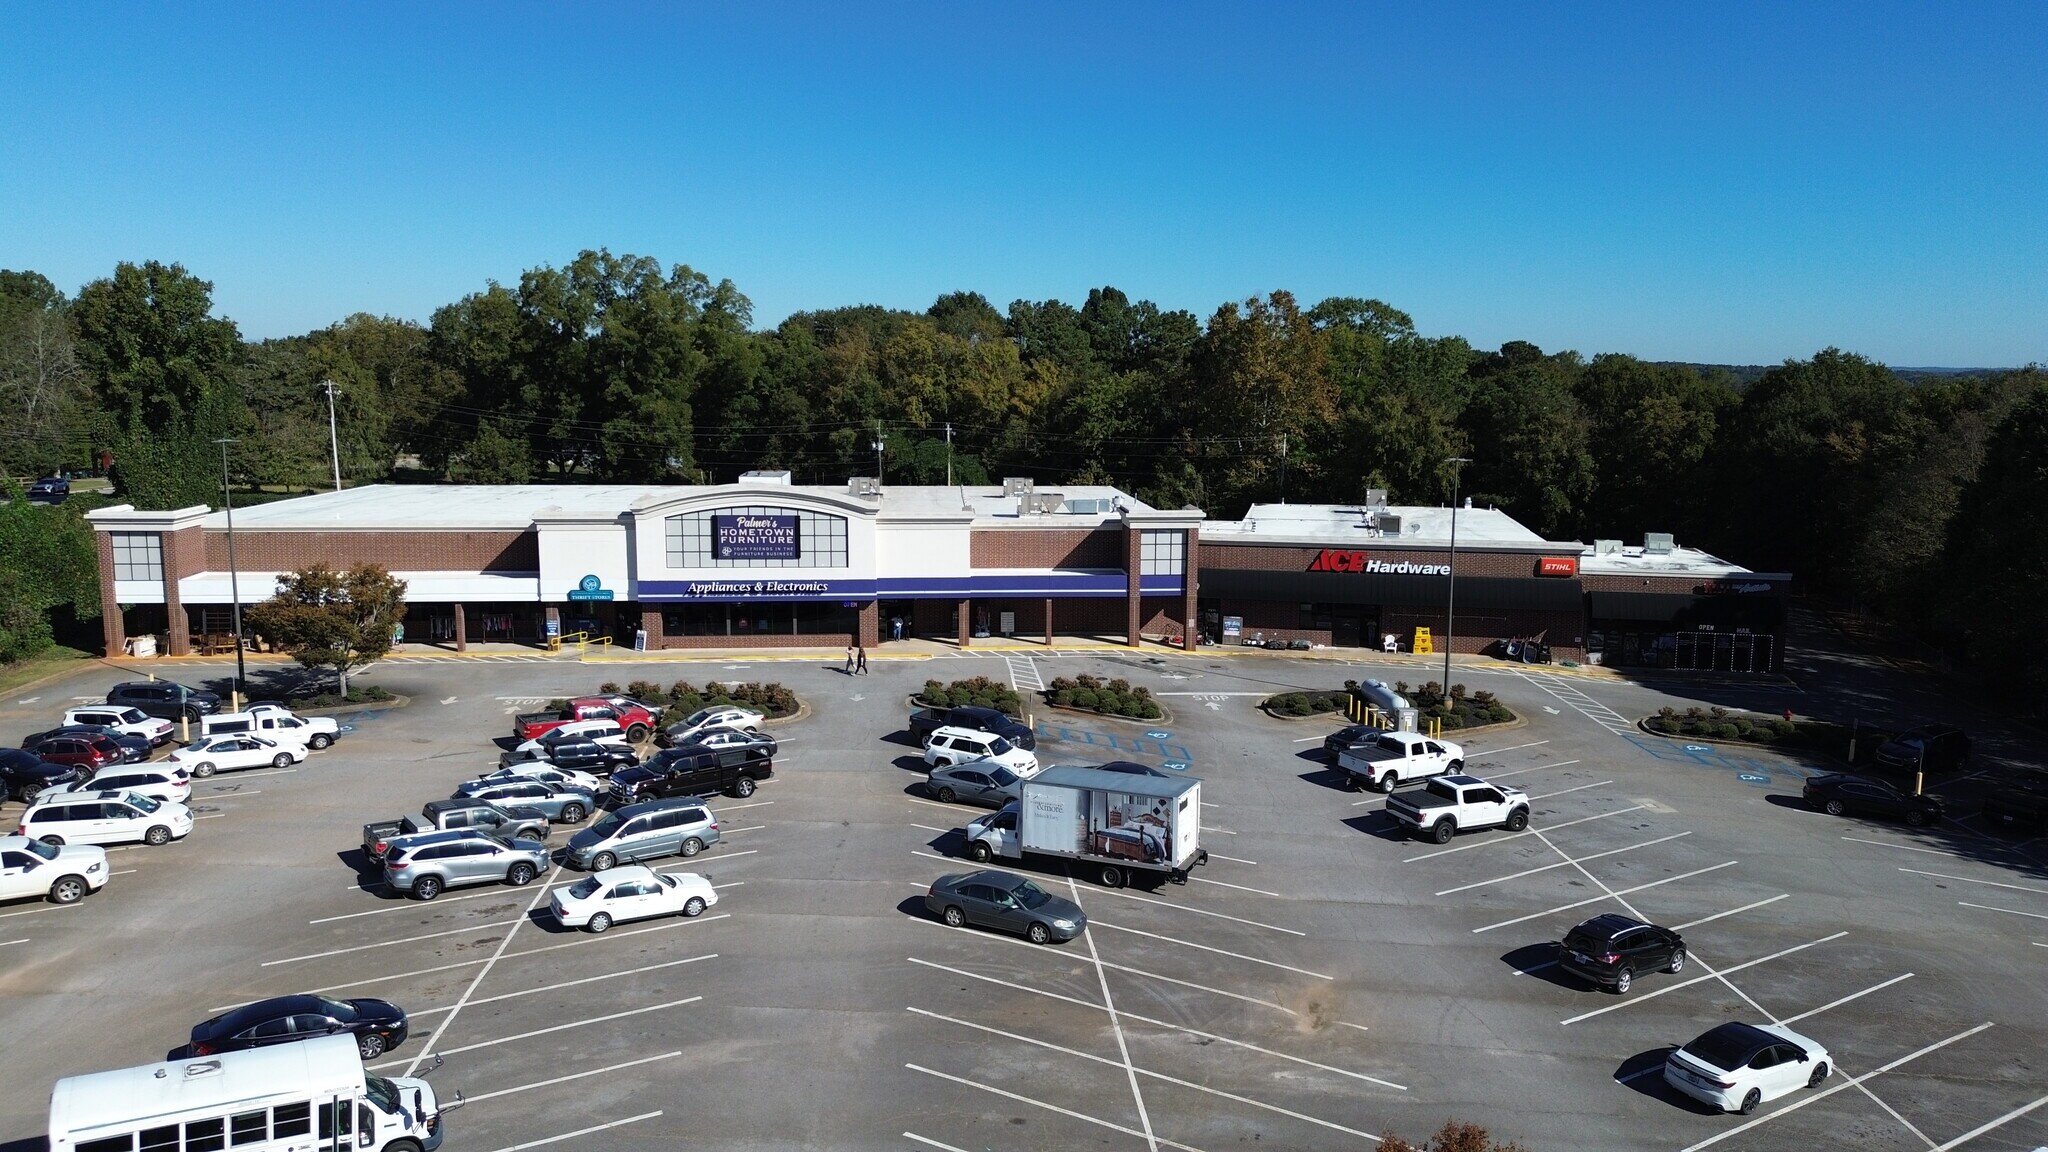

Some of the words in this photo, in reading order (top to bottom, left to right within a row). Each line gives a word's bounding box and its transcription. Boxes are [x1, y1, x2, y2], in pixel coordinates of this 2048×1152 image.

[736, 516, 778, 528] Palmer's
[720, 528, 794, 536] HOMETOWN
[720, 536, 794, 544] FURNITURE
[1309, 547, 1368, 572] ACE
[1366, 560, 1450, 576] Hardware
[1544, 563, 1571, 571] STIHL
[687, 582, 751, 594] Appliances
[754, 582, 764, 592] &
[766, 581, 828, 592] Electronics
